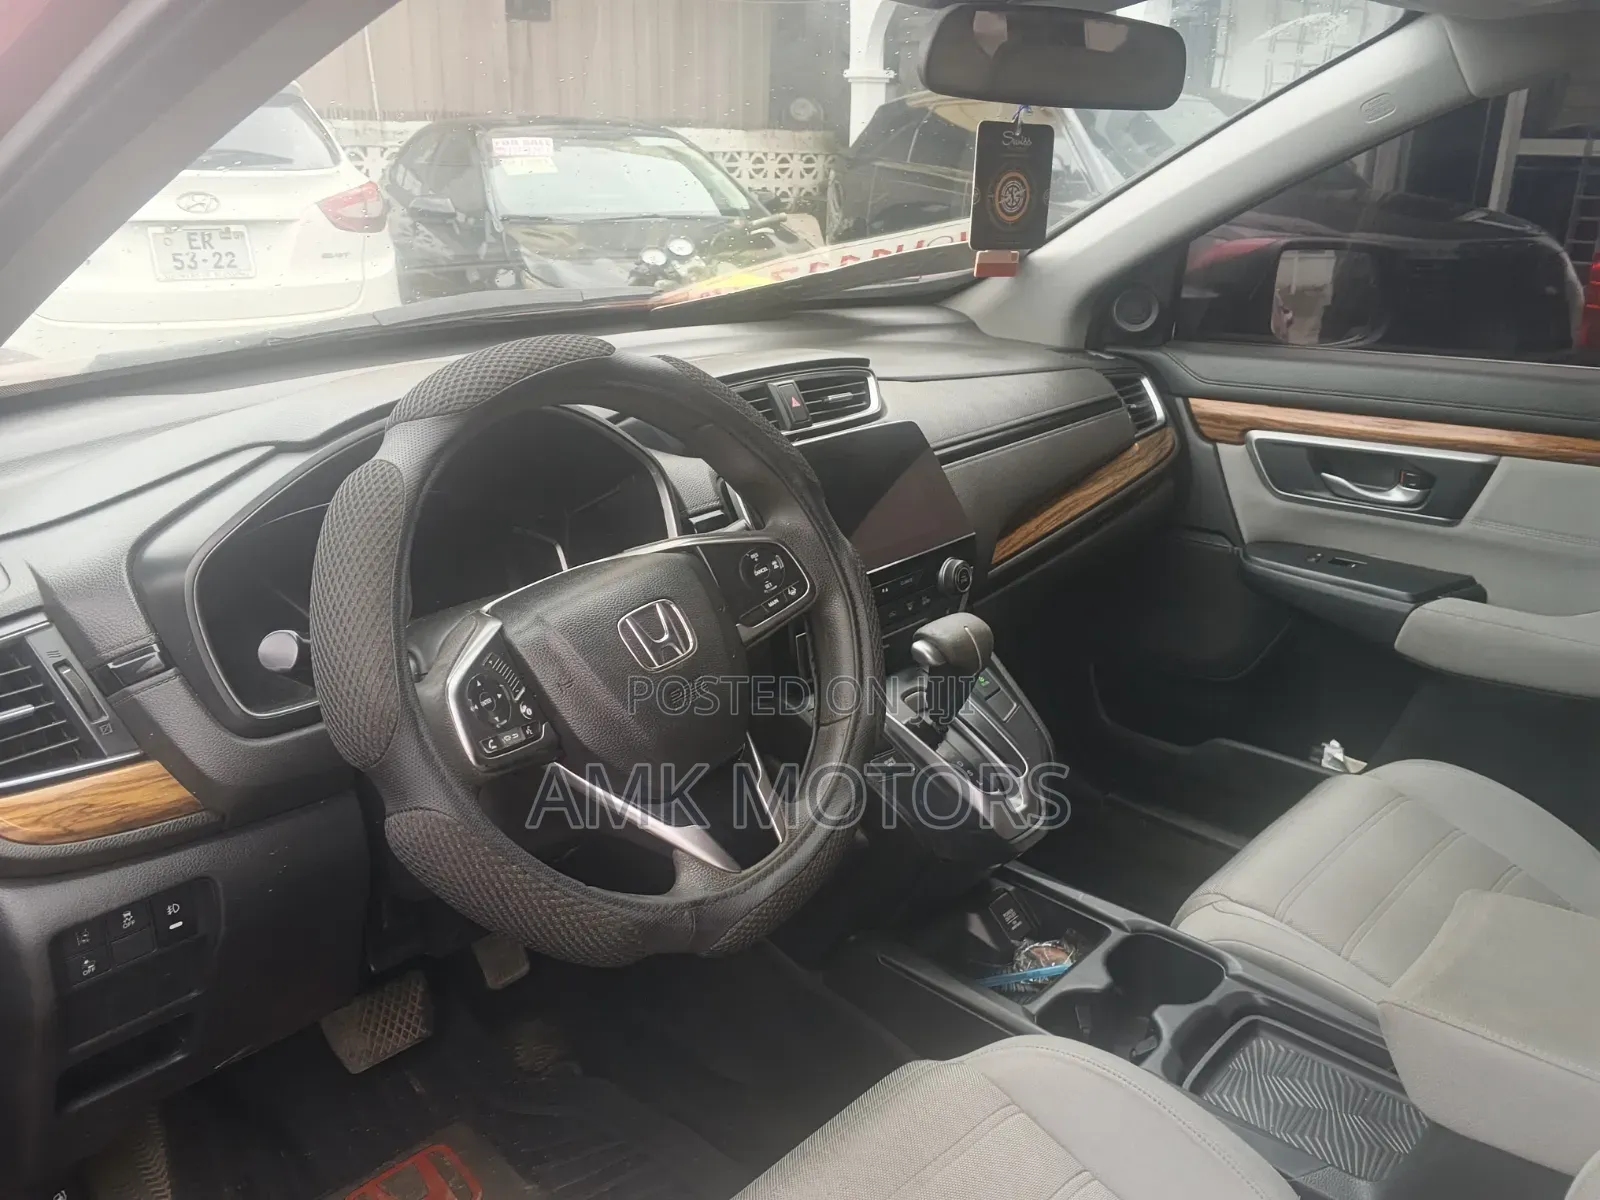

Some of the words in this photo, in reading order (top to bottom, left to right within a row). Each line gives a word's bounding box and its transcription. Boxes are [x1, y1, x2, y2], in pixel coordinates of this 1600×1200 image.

[186, 231, 215, 250] ER
[171, 251, 238, 271] 53-22
[82, 967, 95, 976] OFF
